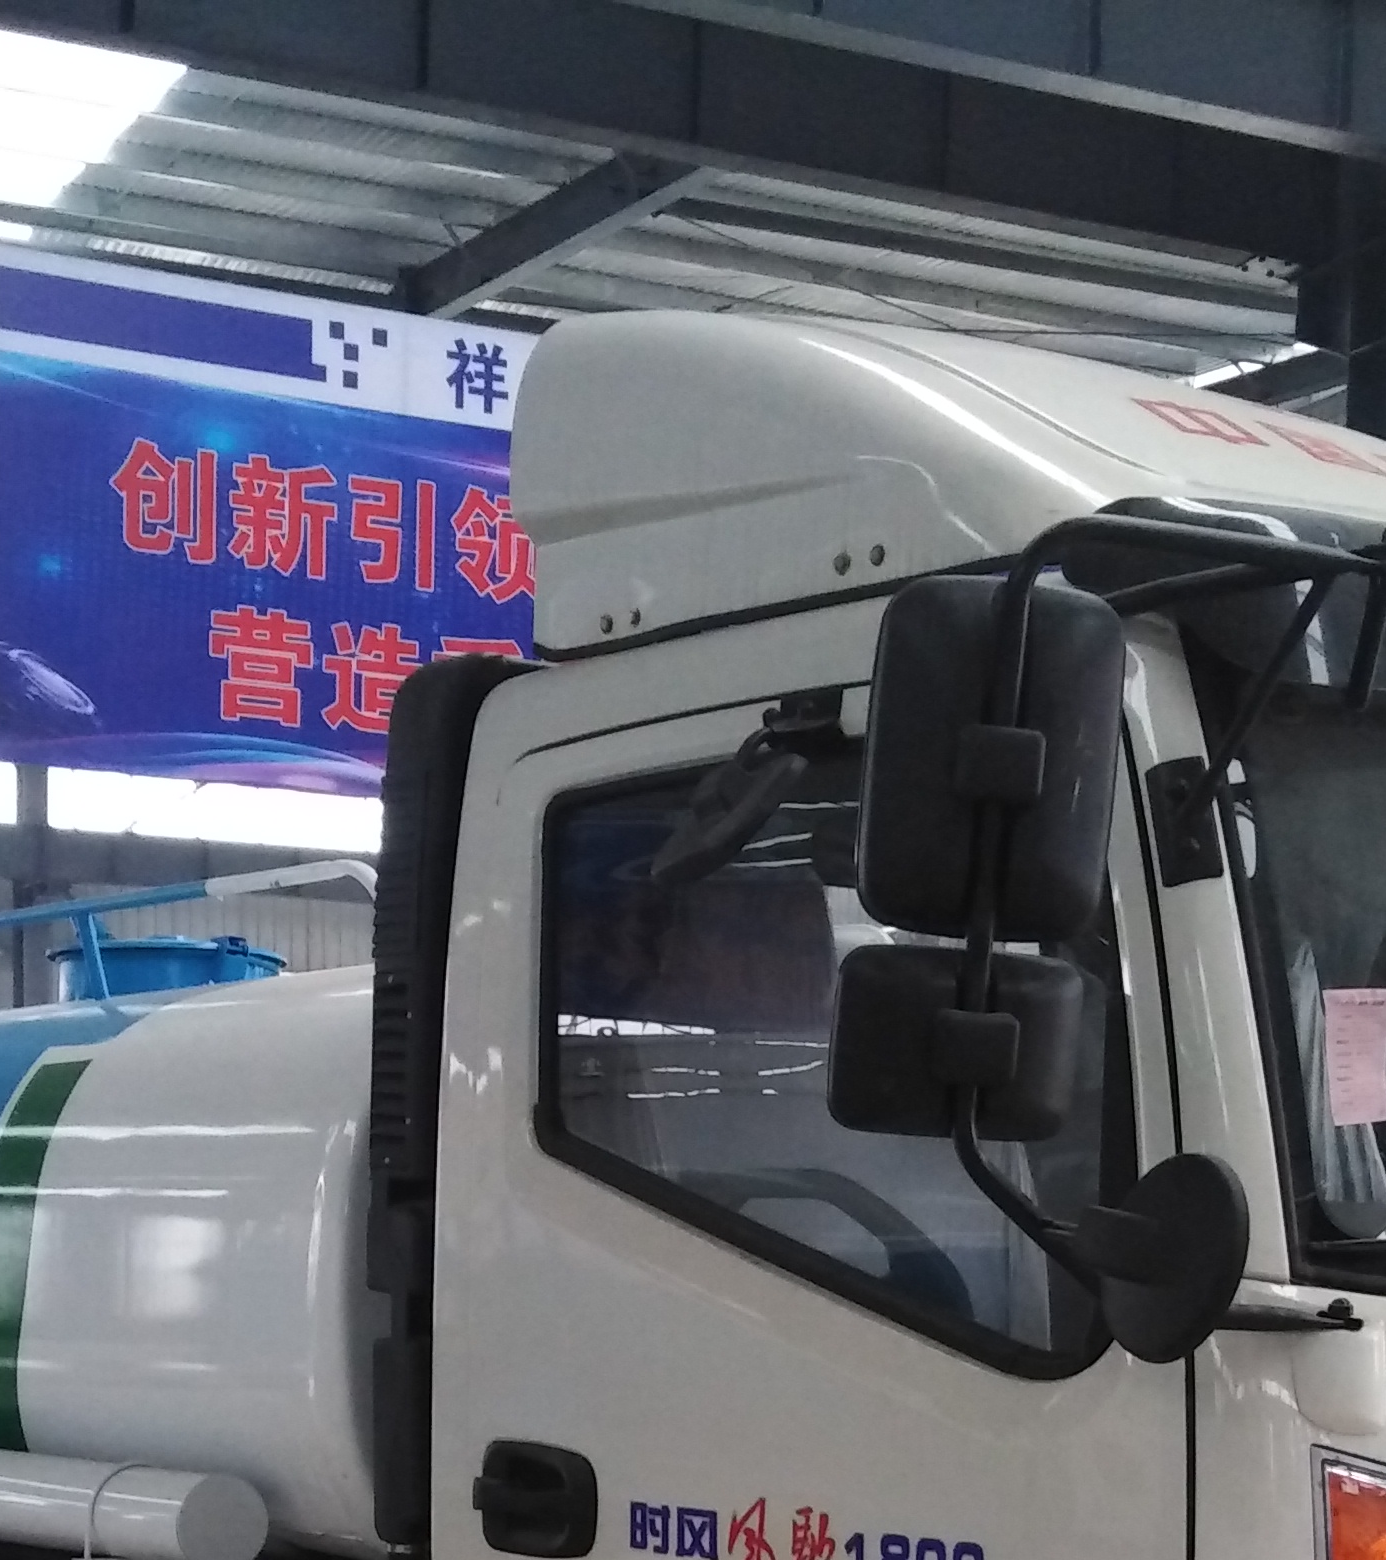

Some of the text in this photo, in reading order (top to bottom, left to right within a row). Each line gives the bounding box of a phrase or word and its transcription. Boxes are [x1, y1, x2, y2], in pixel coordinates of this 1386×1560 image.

[446, 338, 509, 414] 祥
[110, 437, 536, 604] 创新引领
[209, 605, 523, 735] 营造
